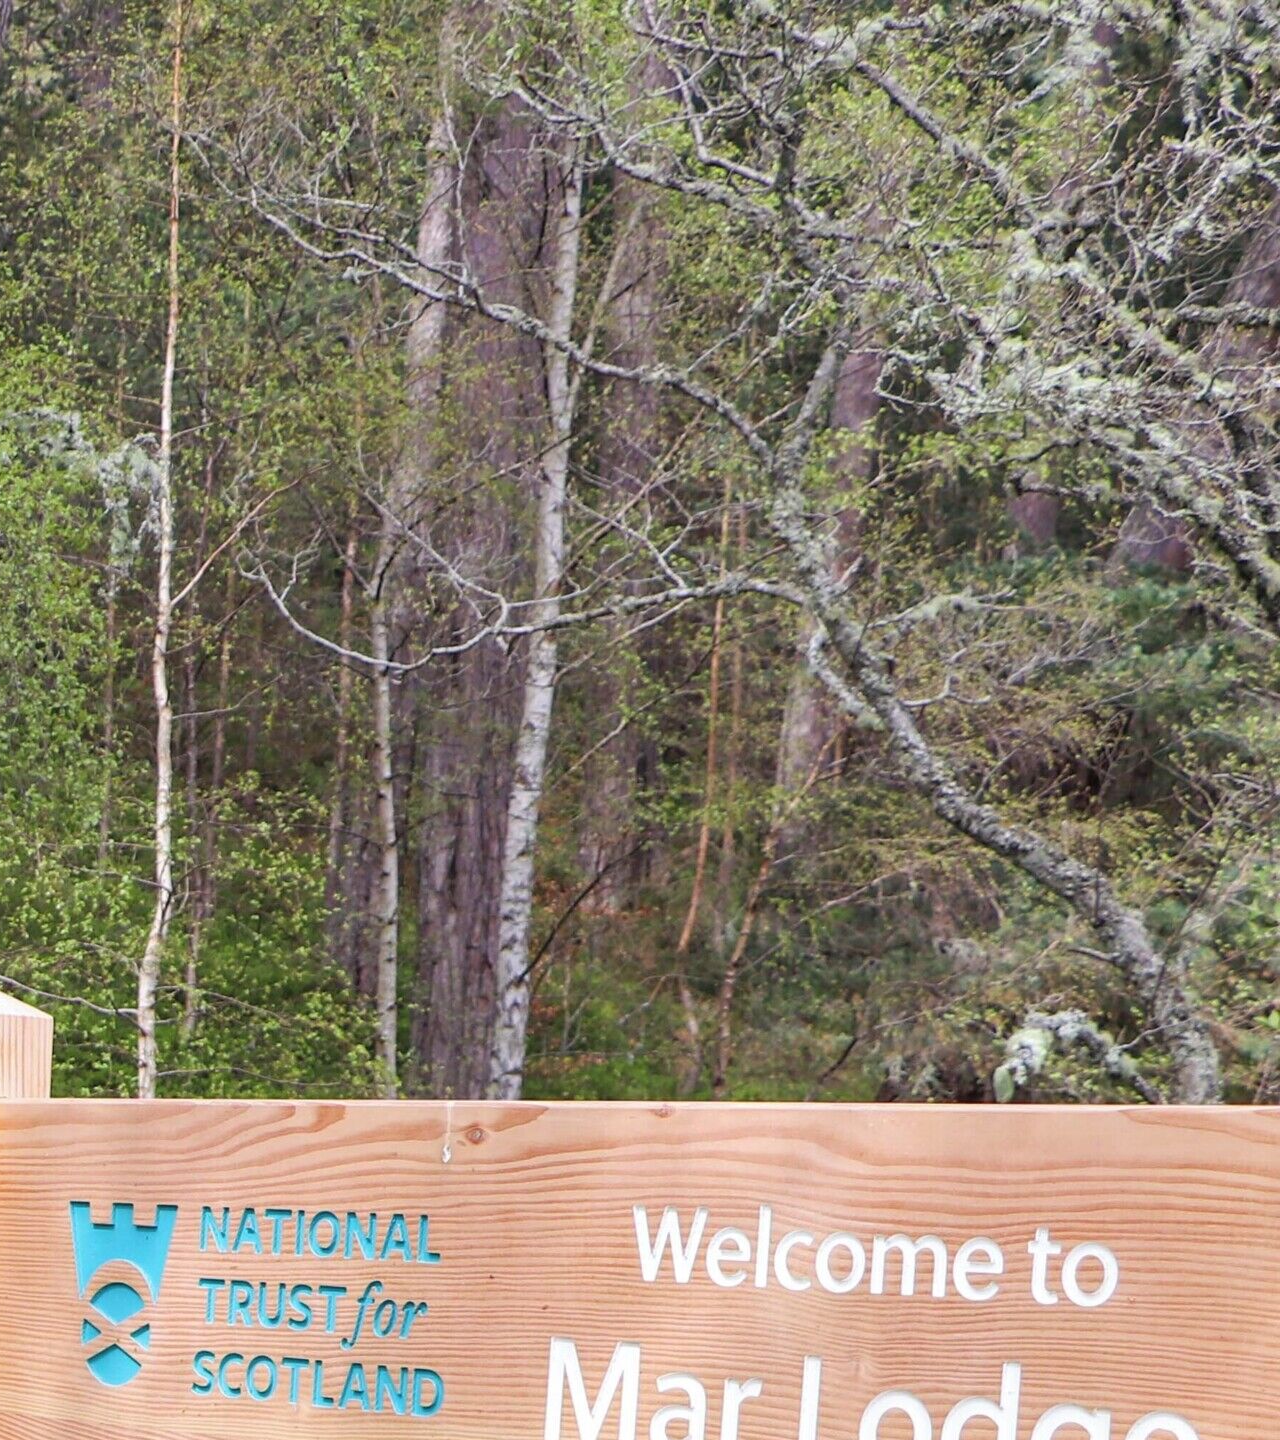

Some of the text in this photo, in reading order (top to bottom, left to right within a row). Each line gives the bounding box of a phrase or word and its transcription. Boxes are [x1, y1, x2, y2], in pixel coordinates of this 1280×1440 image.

[198, 1205, 441, 1264] NATIONAL
[633, 1206, 1119, 1307] Welcome to
[198, 1277, 428, 1349] TRUST for
[191, 1350, 445, 1417] SCOTLAND
